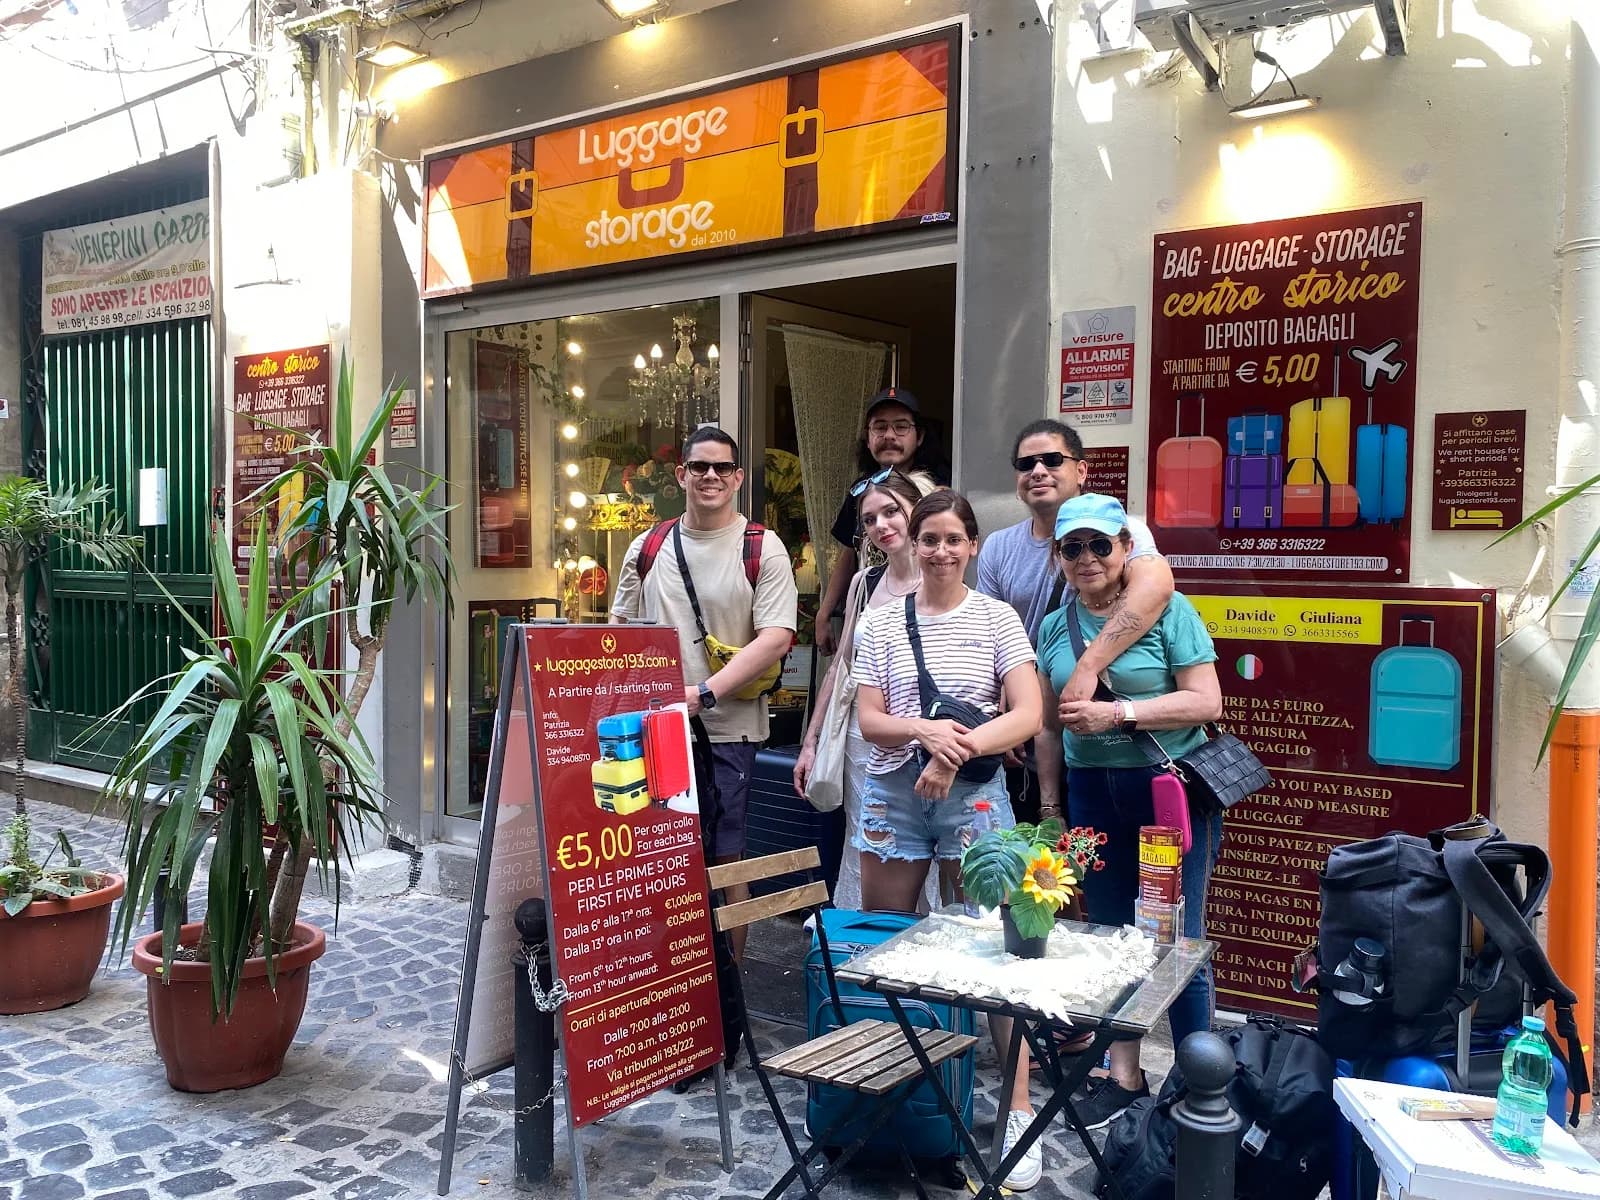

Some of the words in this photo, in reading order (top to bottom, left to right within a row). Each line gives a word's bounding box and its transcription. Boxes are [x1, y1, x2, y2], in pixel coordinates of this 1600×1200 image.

[578, 106, 728, 168] Luggage
[585, 200, 714, 248] storage
[691, 233, 707, 246] dal
[710, 229, 736, 243] 2010
[1163, 246, 1203, 280] BAG
[1211, 234, 1304, 275] LUGGAGE
[1311, 222, 1411, 264] STORAGE
[1163, 276, 1266, 318] centro
[1283, 260, 1406, 309] storico
[51, 295, 77, 316] SONO
[80, 288, 128, 314] APERTE
[131, 286, 147, 305] LE
[89, 315, 99, 326] 45
[100, 314, 111, 325] 98
[145, 306, 161, 318] 334
[164, 304, 182, 316] 596
[184, 302, 196, 313] 32
[199, 299, 211, 311] 98
[1072, 332, 1124, 344] verisure
[1205, 318, 1278, 350] DEPOSITO
[1284, 312, 1355, 344] BAGAGLI
[247, 356, 279, 378] centro
[284, 349, 320, 374] storico
[1065, 348, 1130, 364] ALLARME
[1163, 357, 1203, 375] STARTING
[1205, 355, 1231, 372] FROM
[1069, 363, 1125, 375] zerovision
[1263, 353, 1320, 388] 5,00
[1181, 373, 1216, 390] PARTIRE
[1217, 372, 1230, 388] DA
[236, 392, 252, 413] BAG
[254, 388, 288, 411] LUGGAGE
[290, 384, 326, 408] STORAGE
[282, 409, 309, 428] BAGAGLI
[519, 400, 528, 430] YOUR
[1441, 437, 1457, 446] per
[1458, 436, 1492, 446] periodi
[1494, 435, 1517, 443] brevi
[1443, 430, 1452, 438] Si
[1453, 428, 1493, 438] affittano
[1494, 428, 1516, 436] case
[519, 430, 528, 481] SUITCASE
[1449, 455, 1473, 463] short
[1474, 455, 1508, 464] periods
[1454, 448, 1473, 456] rent
[1474, 447, 1506, 455] houses
[1507, 446, 1520, 454] for
[1458, 468, 1497, 477] Patrizia
[1439, 497, 1516, 505] luggagestore193.com
[1456, 490, 1493, 498] Rivolgersi
[1233, 538, 1254, 550] +39
[1256, 538, 1277, 550] 366
[1279, 538, 1326, 551] 3316322
[1199, 556, 1214, 567] AND
[1215, 556, 1246, 568] CLOSING
[1226, 608, 1276, 622] Davide
[1300, 611, 1362, 625] Giuliana
[546, 654, 668, 676] luggagestore193.com
[548, 687, 557, 698] A
[558, 685, 593, 698] Partire
[594, 683, 607, 695] da
[614, 681, 650, 695] starting
[651, 680, 673, 692] from
[1251, 697, 1270, 709] DA
[1272, 699, 1280, 710] 5
[1284, 700, 1324, 713] EURO
[544, 720, 570, 730] Patrizia
[544, 731, 558, 740] 366
[1239, 724, 1248, 735] E
[1251, 725, 1307, 741] MISURA
[546, 746, 571, 756] Davide
[547, 757, 561, 766] 334
[561, 753, 591, 765] 9408570
[1279, 778, 1310, 792] YOU
[1313, 781, 1342, 796] PAY
[1343, 784, 1393, 801] BASED
[1234, 808, 1304, 826] LUGGAGE
[1283, 797, 1314, 810] AND
[1317, 800, 1390, 818] MEASURE
[634, 826, 651, 838] Per
[651, 818, 672, 836] ogni
[673, 815, 694, 829] collo
[556, 823, 633, 870] €5,00
[637, 839, 652, 852] For
[654, 834, 676, 848] each
[677, 830, 694, 843] bag
[1228, 831, 1265, 847] VOUS
[1268, 836, 1313, 852] PAYEZ
[1141, 852, 1172, 865] BAGAGLI
[1223, 848, 1280, 865] INSÉREZ
[568, 877, 596, 897] PER
[598, 872, 613, 888] LE
[616, 862, 655, 884] PRIME
[657, 860, 665, 873] 5
[665, 853, 691, 870] ORE
[1212, 864, 1273, 882] MESUREZ
[1283, 873, 1300, 886] LE
[577, 891, 613, 914] FIRST
[615, 883, 643, 904] FIVE
[645, 872, 687, 895] HOURS
[1245, 890, 1290, 907] PAGAS
[1293, 897, 1312, 910] EN
[563, 924, 590, 940] Dalla
[602, 914, 620, 929] alla
[635, 906, 653, 919] ora:
[1230, 922, 1248, 935] TU
[563, 943, 590, 960] Dalla
[606, 934, 622, 946] ora
[623, 929, 633, 941] in
[635, 924, 651, 940] poi:
[1227, 952, 1244, 965] JE
[1247, 956, 1287, 973] NACH
[568, 968, 596, 985] From
[605, 963, 614, 974] to
[1230, 970, 1254, 984] EIN
[1257, 975, 1287, 990] UND
[568, 987, 592, 1002] From
[608, 975, 627, 989] hour
[570, 1014, 596, 1033] Orari
[597, 1009, 607, 1023] di
[608, 981, 688, 1020] apertura/Opening
[689, 972, 713, 989] hours
[603, 1027, 629, 1046] Dalle
[630, 1017, 650, 1035] 7:00
[651, 1011, 668, 1027] alle
[669, 1002, 690, 1020] 21:00
[586, 1053, 614, 1073] From
[615, 1043, 636, 1059] 7:00
[637, 1036, 658, 1050] a.m.
[658, 1031, 668, 1042] to
[669, 1022, 689, 1038] 9:00
[690, 1016, 708, 1033] p.m.
[607, 1069, 623, 1083] Via
[623, 1051, 663, 1076] tribunali
[664, 1037, 695, 1059] 193/222
[601, 1092, 610, 1101] Le
[609, 1081, 630, 1097] valigie
[635, 1070, 658, 1088] pagano
[664, 1061, 677, 1073] base
[687, 1047, 714, 1065] grandezza
[603, 1093, 631, 1110] Luggage
[631, 1085, 646, 1100] price
[651, 1075, 669, 1089] based
[668, 1072, 677, 1081] on
[683, 1064, 695, 1075] size
